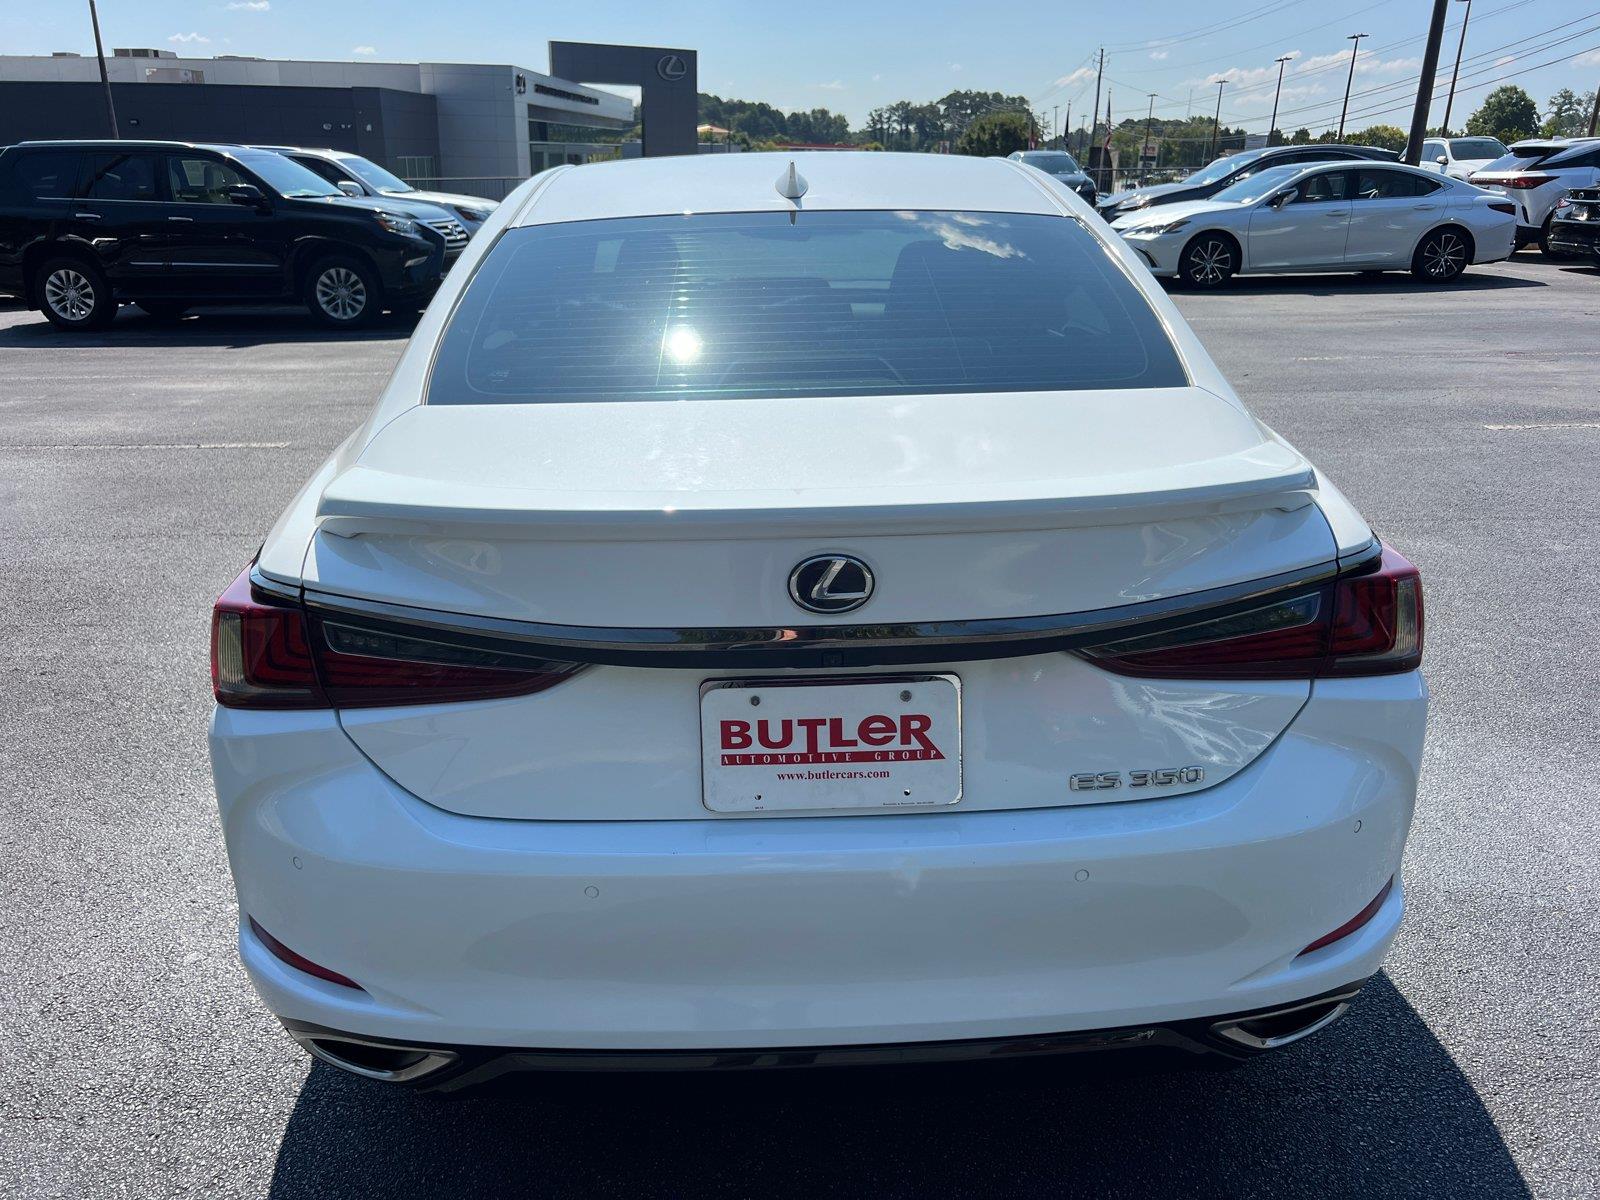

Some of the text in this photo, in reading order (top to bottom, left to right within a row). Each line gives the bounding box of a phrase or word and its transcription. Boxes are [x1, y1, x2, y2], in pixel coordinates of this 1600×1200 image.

[722, 750, 937, 765] AUTOMOTIVE GROUP
[776, 769, 890, 781] www.butlercars.com
[1069, 766, 1204, 792] ES 350
